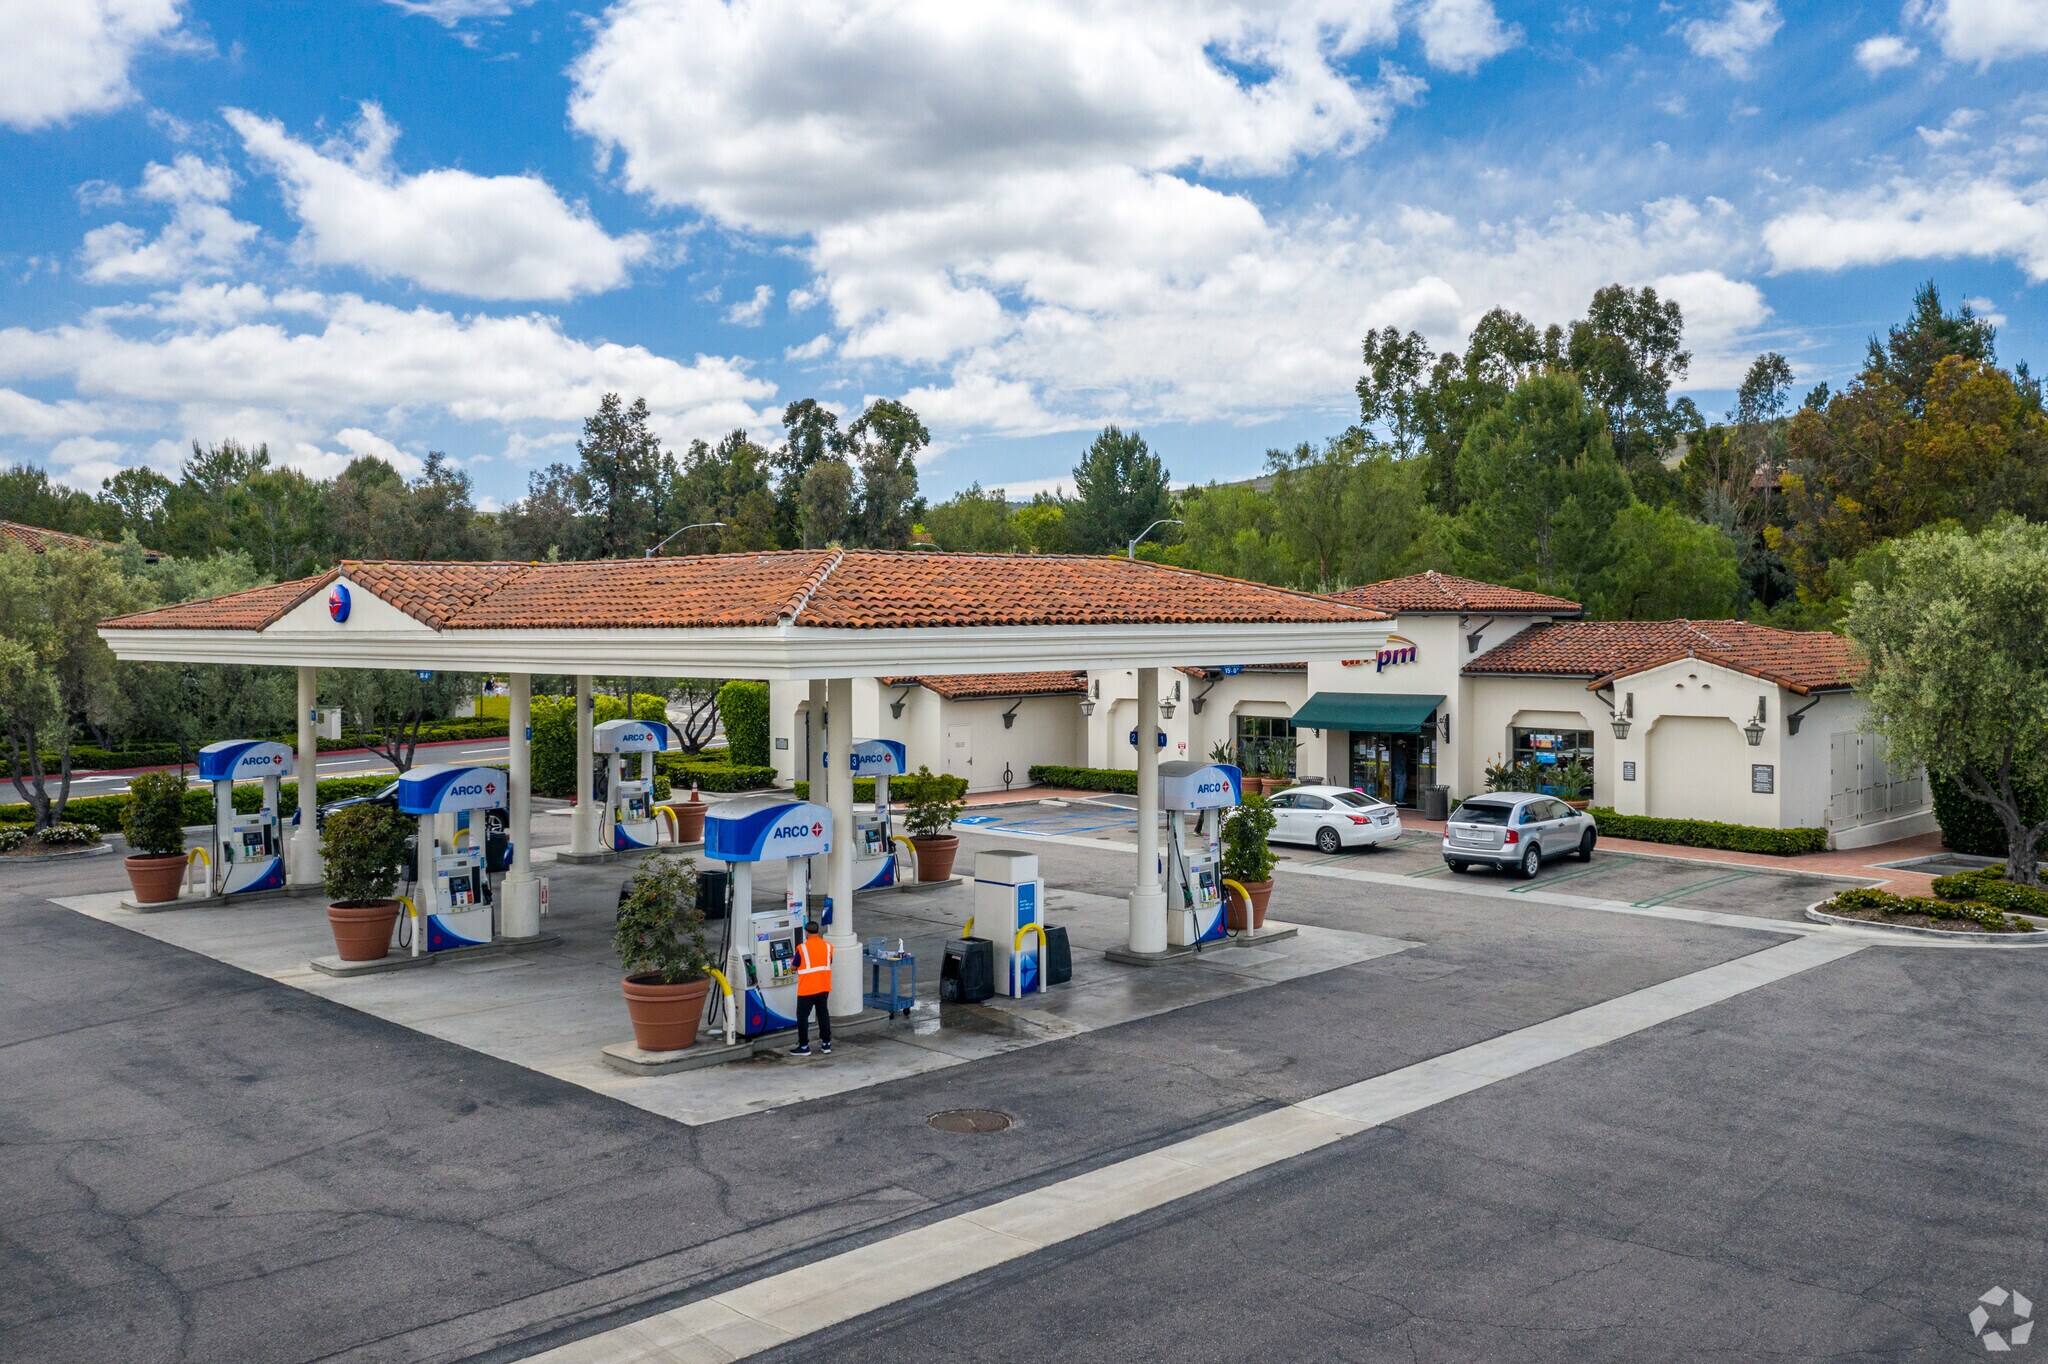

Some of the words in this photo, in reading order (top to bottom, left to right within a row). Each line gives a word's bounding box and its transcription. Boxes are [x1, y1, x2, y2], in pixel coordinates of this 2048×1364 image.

[622, 733, 644, 741] ARCO
[1131, 733, 1136, 741] 2
[242, 756, 270, 766] ARCO
[852, 756, 857, 766] 3
[859, 754, 883, 764] ARCO
[450, 785, 482, 796] ARCO
[1197, 782, 1220, 793] ARCO
[774, 825, 809, 839] ARCO
[823, 843, 829, 852] 3
